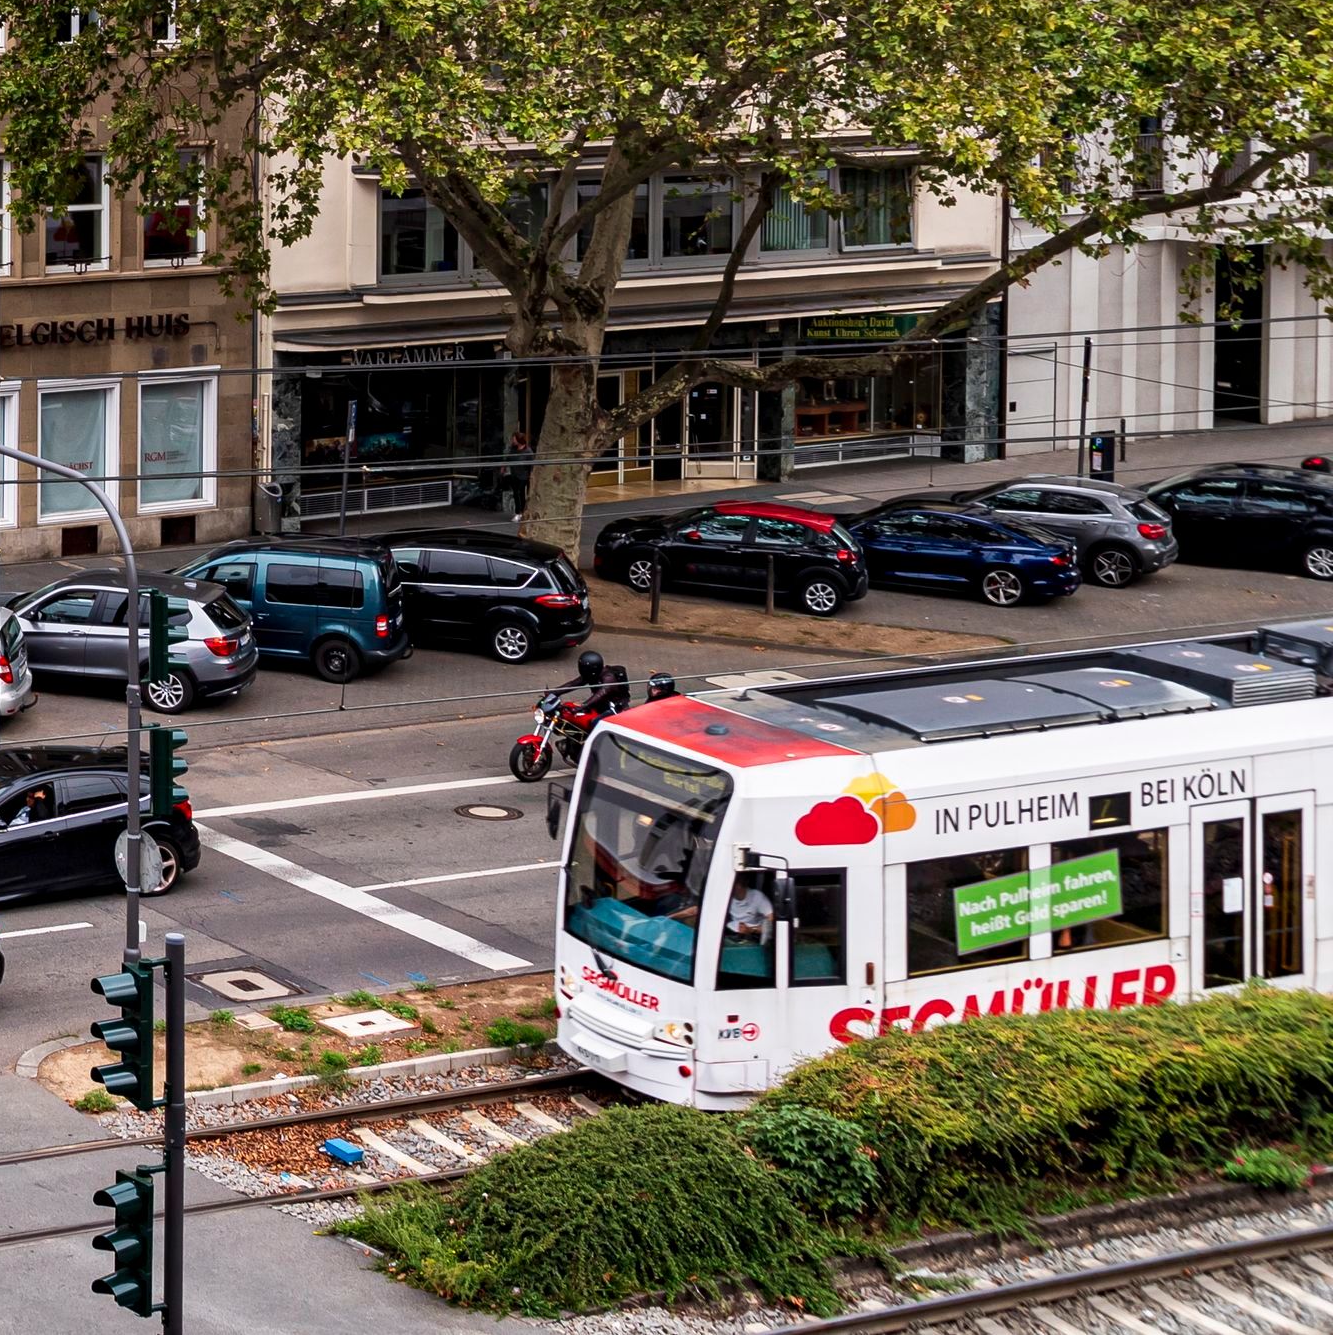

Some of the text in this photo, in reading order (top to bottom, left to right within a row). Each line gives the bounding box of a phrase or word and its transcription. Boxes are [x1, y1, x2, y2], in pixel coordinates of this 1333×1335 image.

[125, 313, 190, 338] HUIS
[869, 316, 895, 327] David
[144, 451, 166, 462] RGM
[1140, 768, 1247, 808] BEI KÖLN
[935, 791, 1080, 835] IN PULHEIM
[959, 868, 1116, 917] Nach Pulheim fahren,
[970, 915, 1012, 938] heißt
[1051, 890, 1108, 918] sparen!
